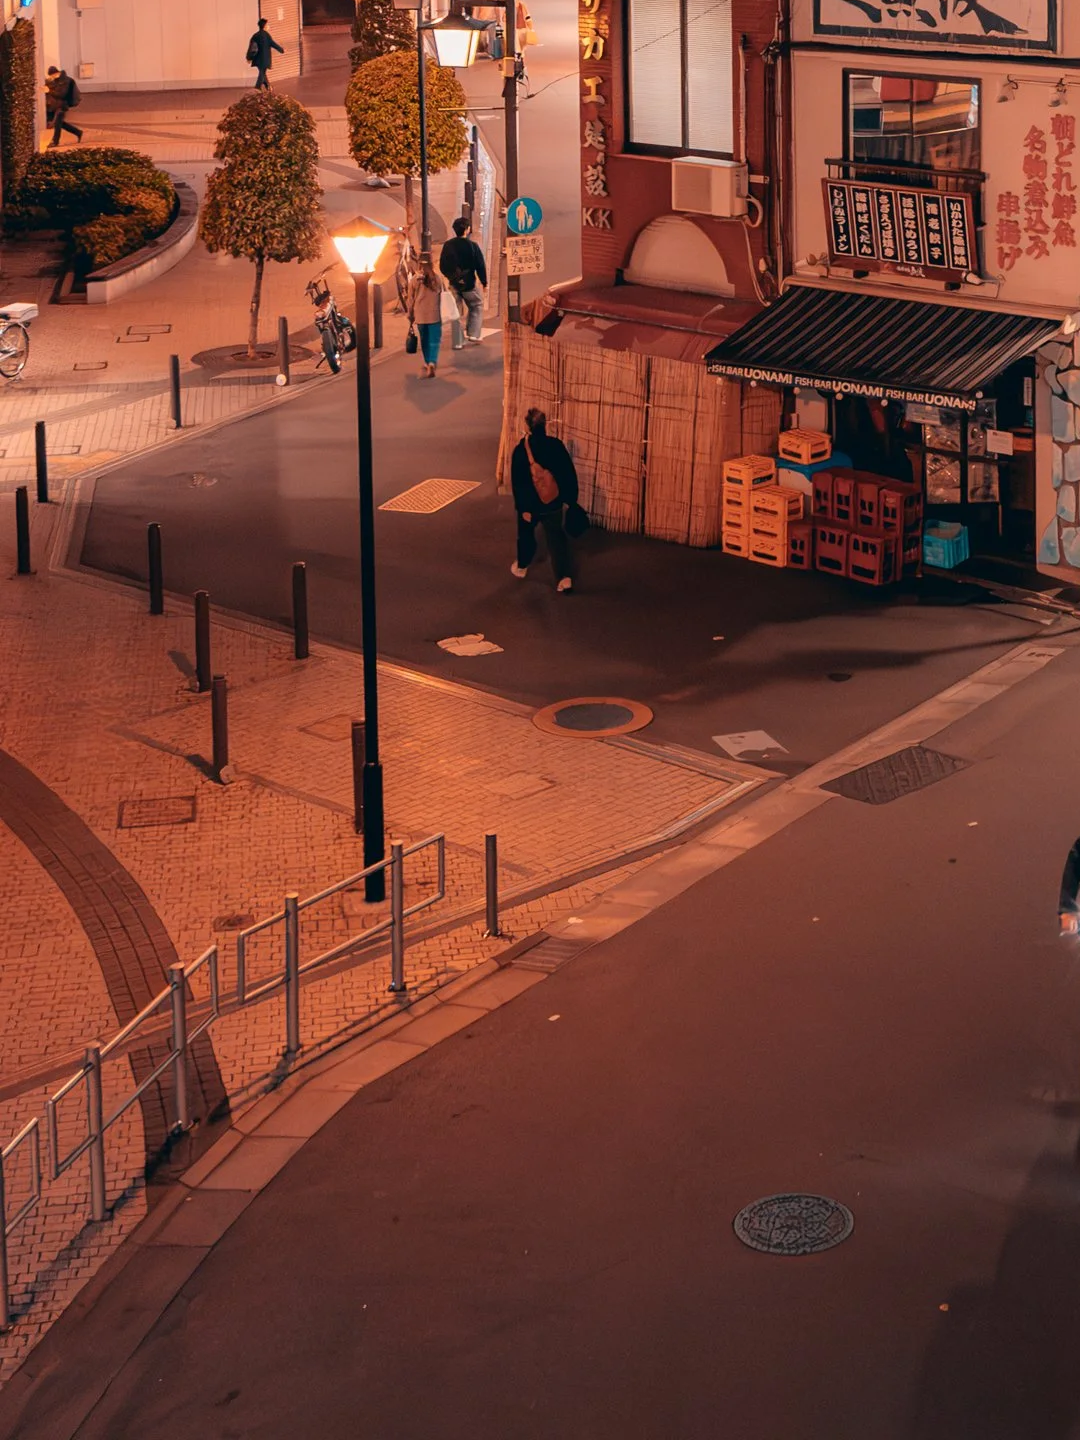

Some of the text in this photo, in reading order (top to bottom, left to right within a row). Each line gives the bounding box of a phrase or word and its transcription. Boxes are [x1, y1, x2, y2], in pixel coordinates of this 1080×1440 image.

[995, 191, 1023, 271] 串揚げ
[1022, 125, 1050, 260] 名物煮込み
[1050, 113, 1077, 247] 朝どれ鮮魚
[726, 367, 743, 377] BAR
[743, 368, 793, 385] UONAMI
[794, 376, 813, 387] FISH
[813, 379, 832, 390] BAR
[832, 380, 883, 398] UONAMI
[885, 388, 905, 400] FISH
[905, 391, 924, 403] BAR
